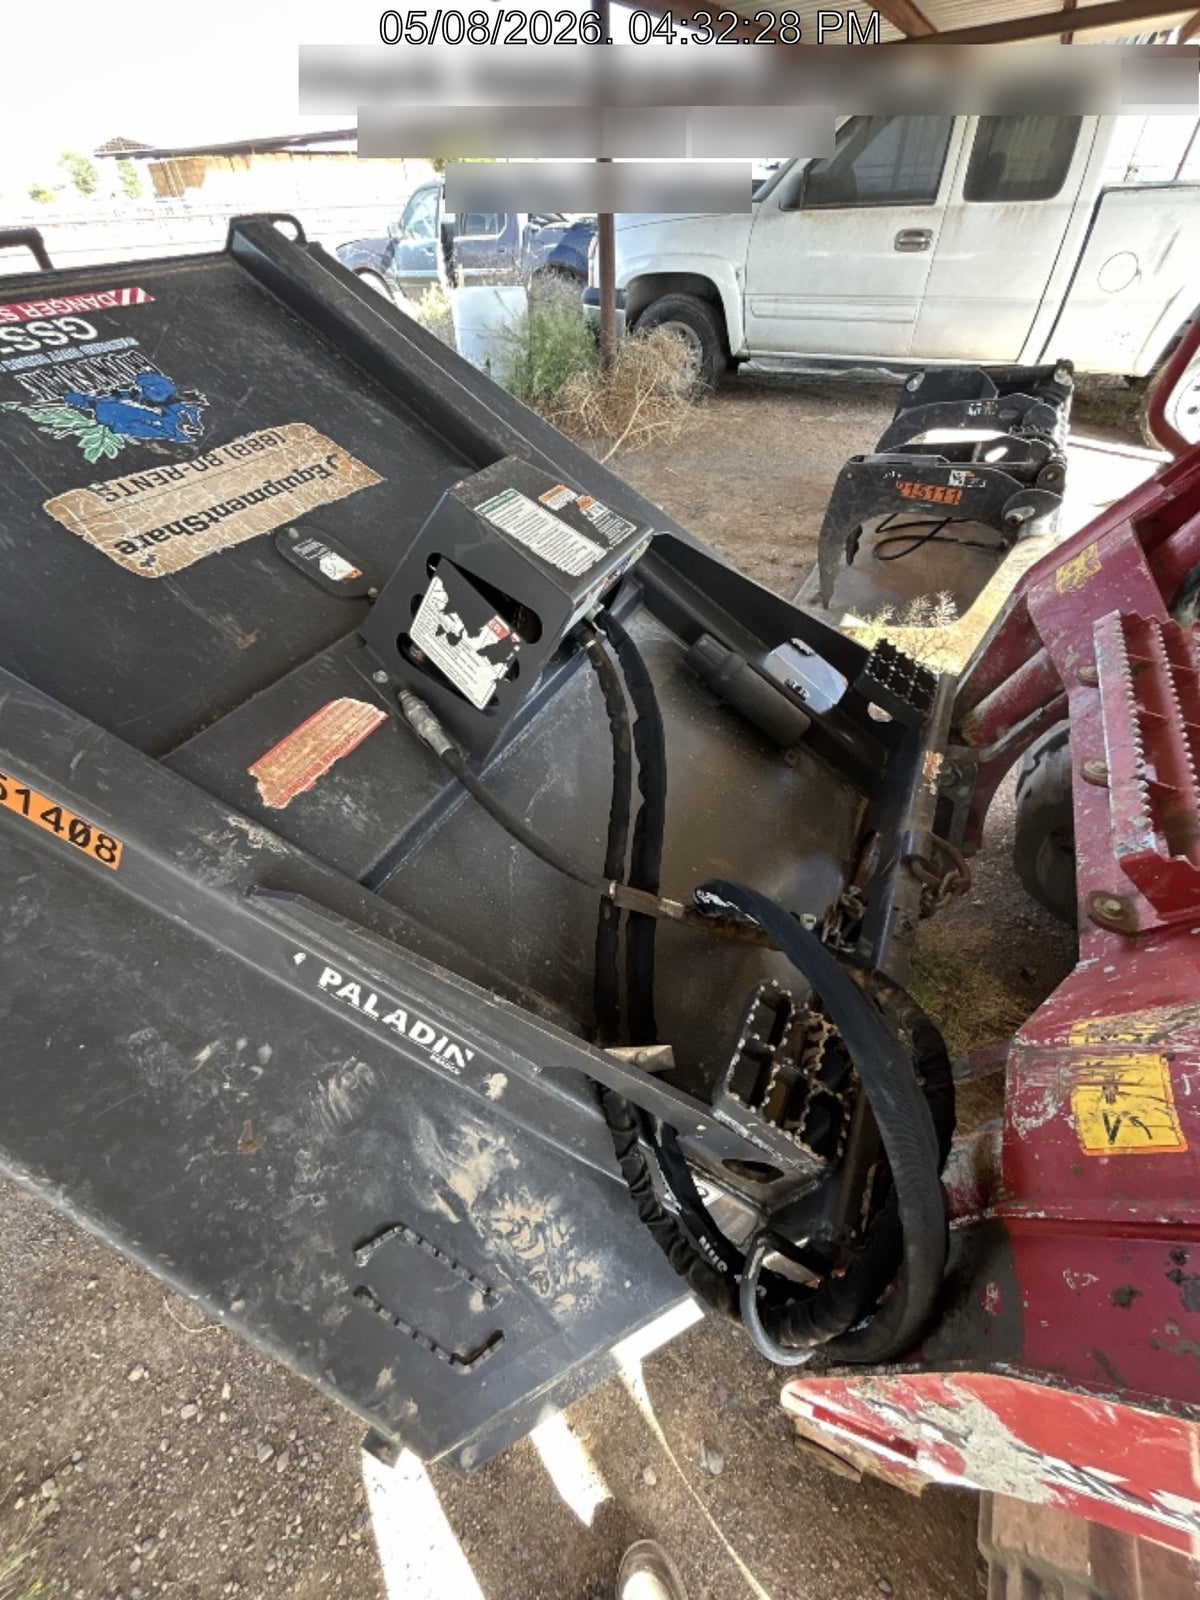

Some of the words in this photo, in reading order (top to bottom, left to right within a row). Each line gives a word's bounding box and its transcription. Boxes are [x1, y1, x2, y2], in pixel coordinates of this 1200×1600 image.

[0, 307, 20, 323] S
[16, 293, 117, 318] DANGER
[228, 430, 286, 461] (888)
[113, 463, 333, 556] EquipmentShare
[317, 966, 475, 1069] PALADIN
